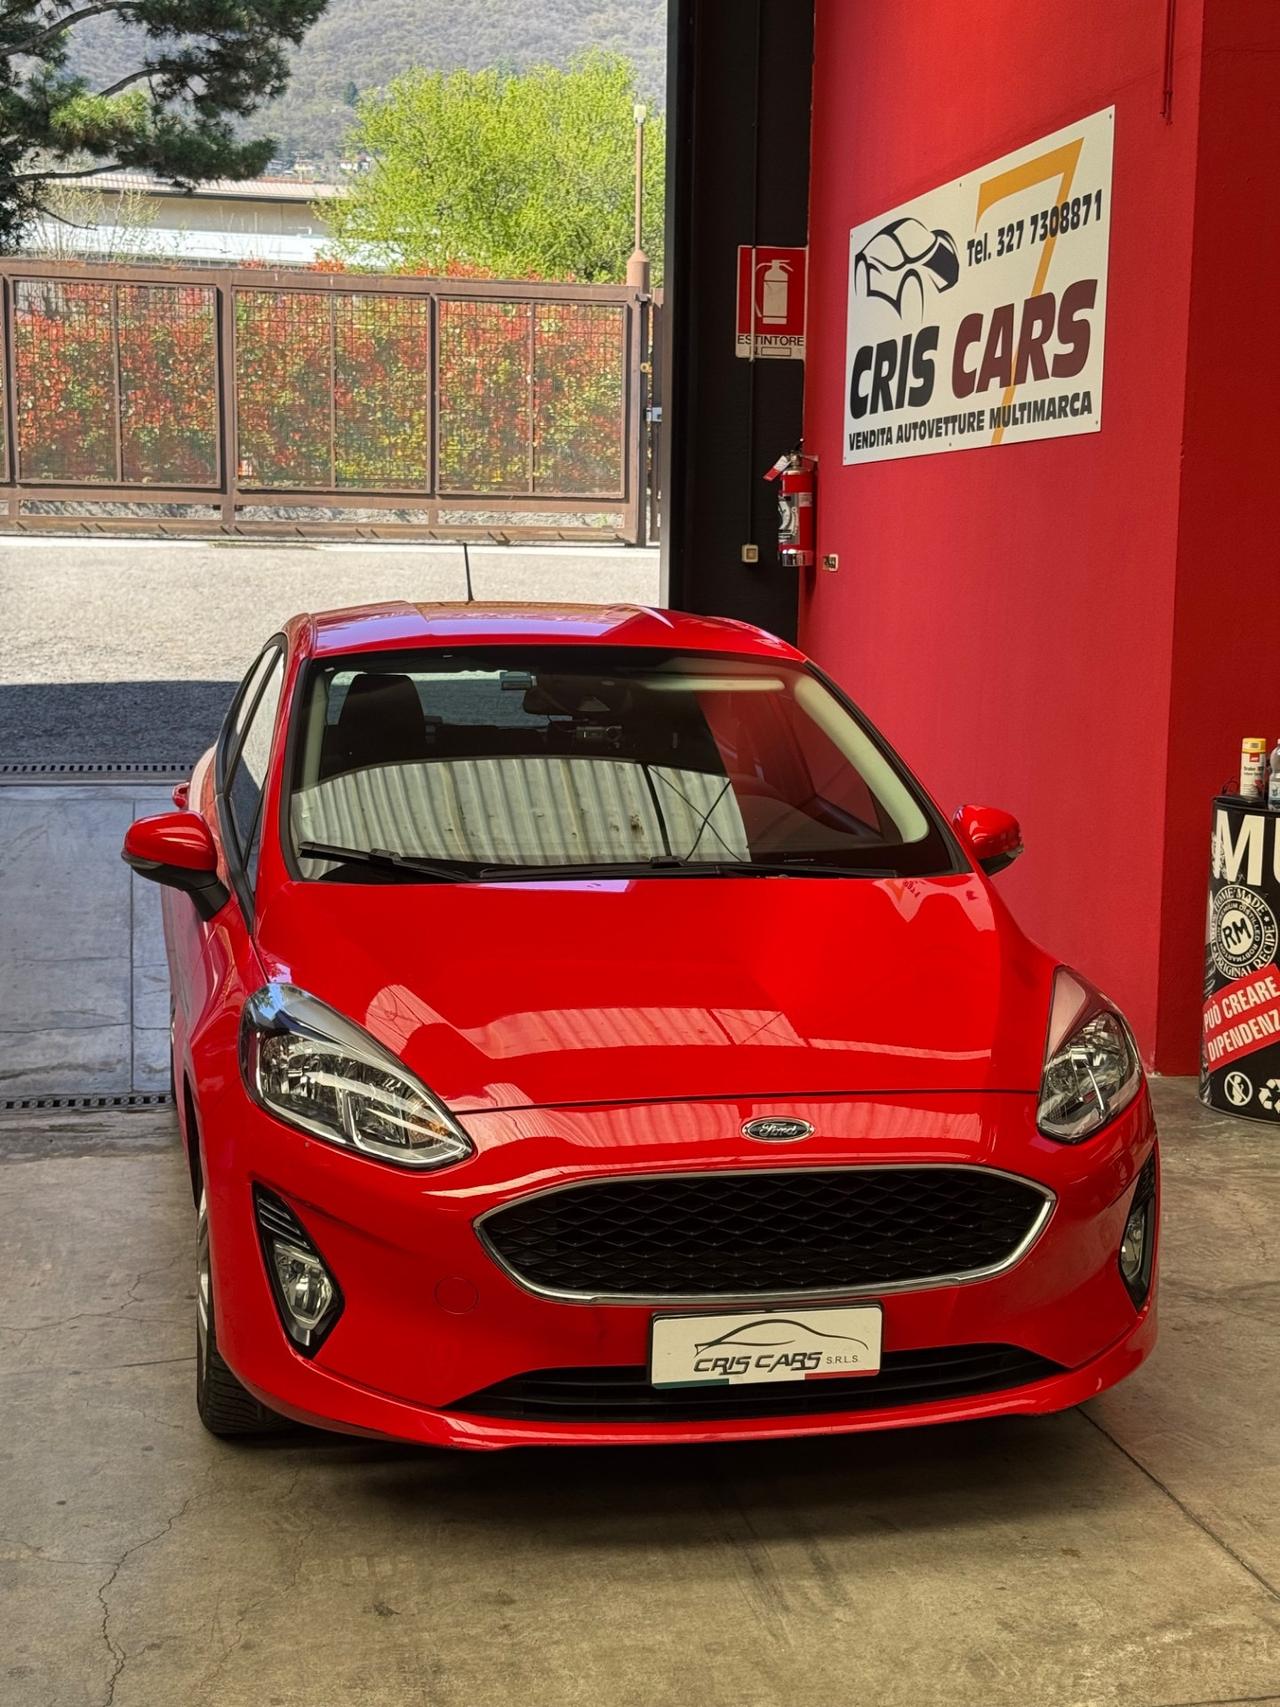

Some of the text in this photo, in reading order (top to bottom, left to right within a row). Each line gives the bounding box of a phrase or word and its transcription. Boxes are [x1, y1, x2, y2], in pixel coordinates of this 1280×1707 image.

[966, 188, 1103, 267] Tel. 327 7308871
[737, 334, 804, 346] ESTINTORE
[849, 279, 1098, 420] CRIS CARS
[848, 390, 1093, 451] VENDITA AUTOVETTURE MULTIMARCA
[1236, 888, 1268, 915] MADE
[1222, 917, 1252, 949] RM
[1252, 925, 1275, 969] RECIPE
[1203, 976, 1280, 1033] PUÒ CREARE
[759, 1122, 797, 1136] Ford
[693, 1355, 752, 1375] CRIS
[754, 1351, 824, 1373] CARS
